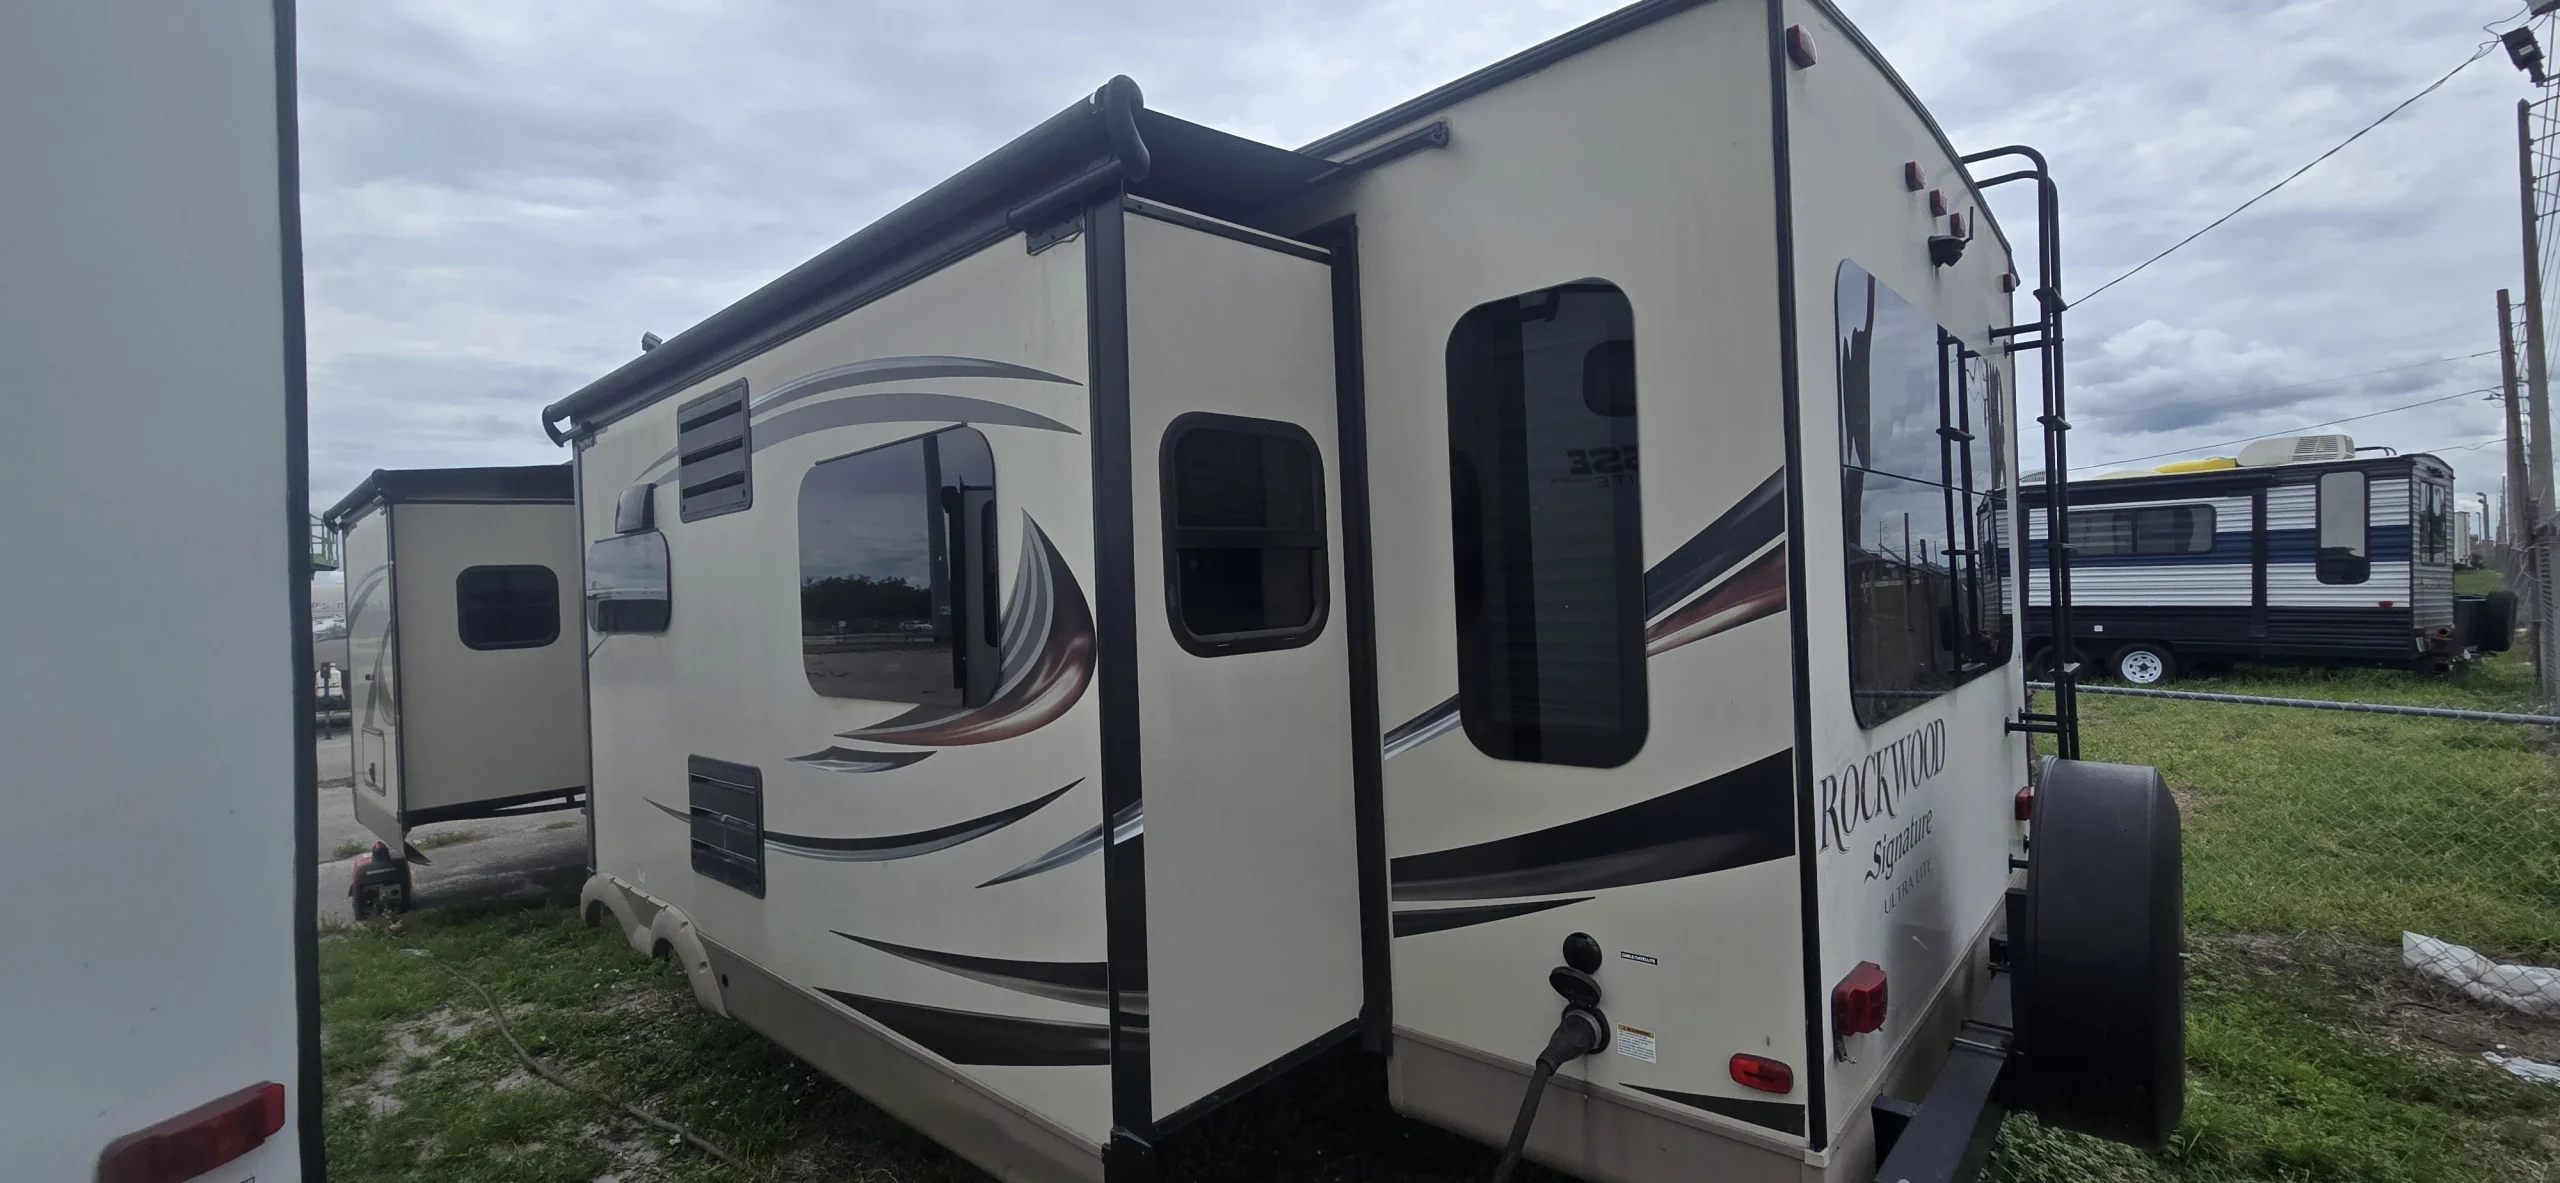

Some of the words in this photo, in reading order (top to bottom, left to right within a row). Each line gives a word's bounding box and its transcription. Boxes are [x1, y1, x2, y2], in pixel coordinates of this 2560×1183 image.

[1819, 718, 1946, 854] ROCKWOOD
[1864, 809, 1933, 884] Signature
[1884, 876, 1915, 914] ULTRA
[1914, 857, 1933, 884] LITE
